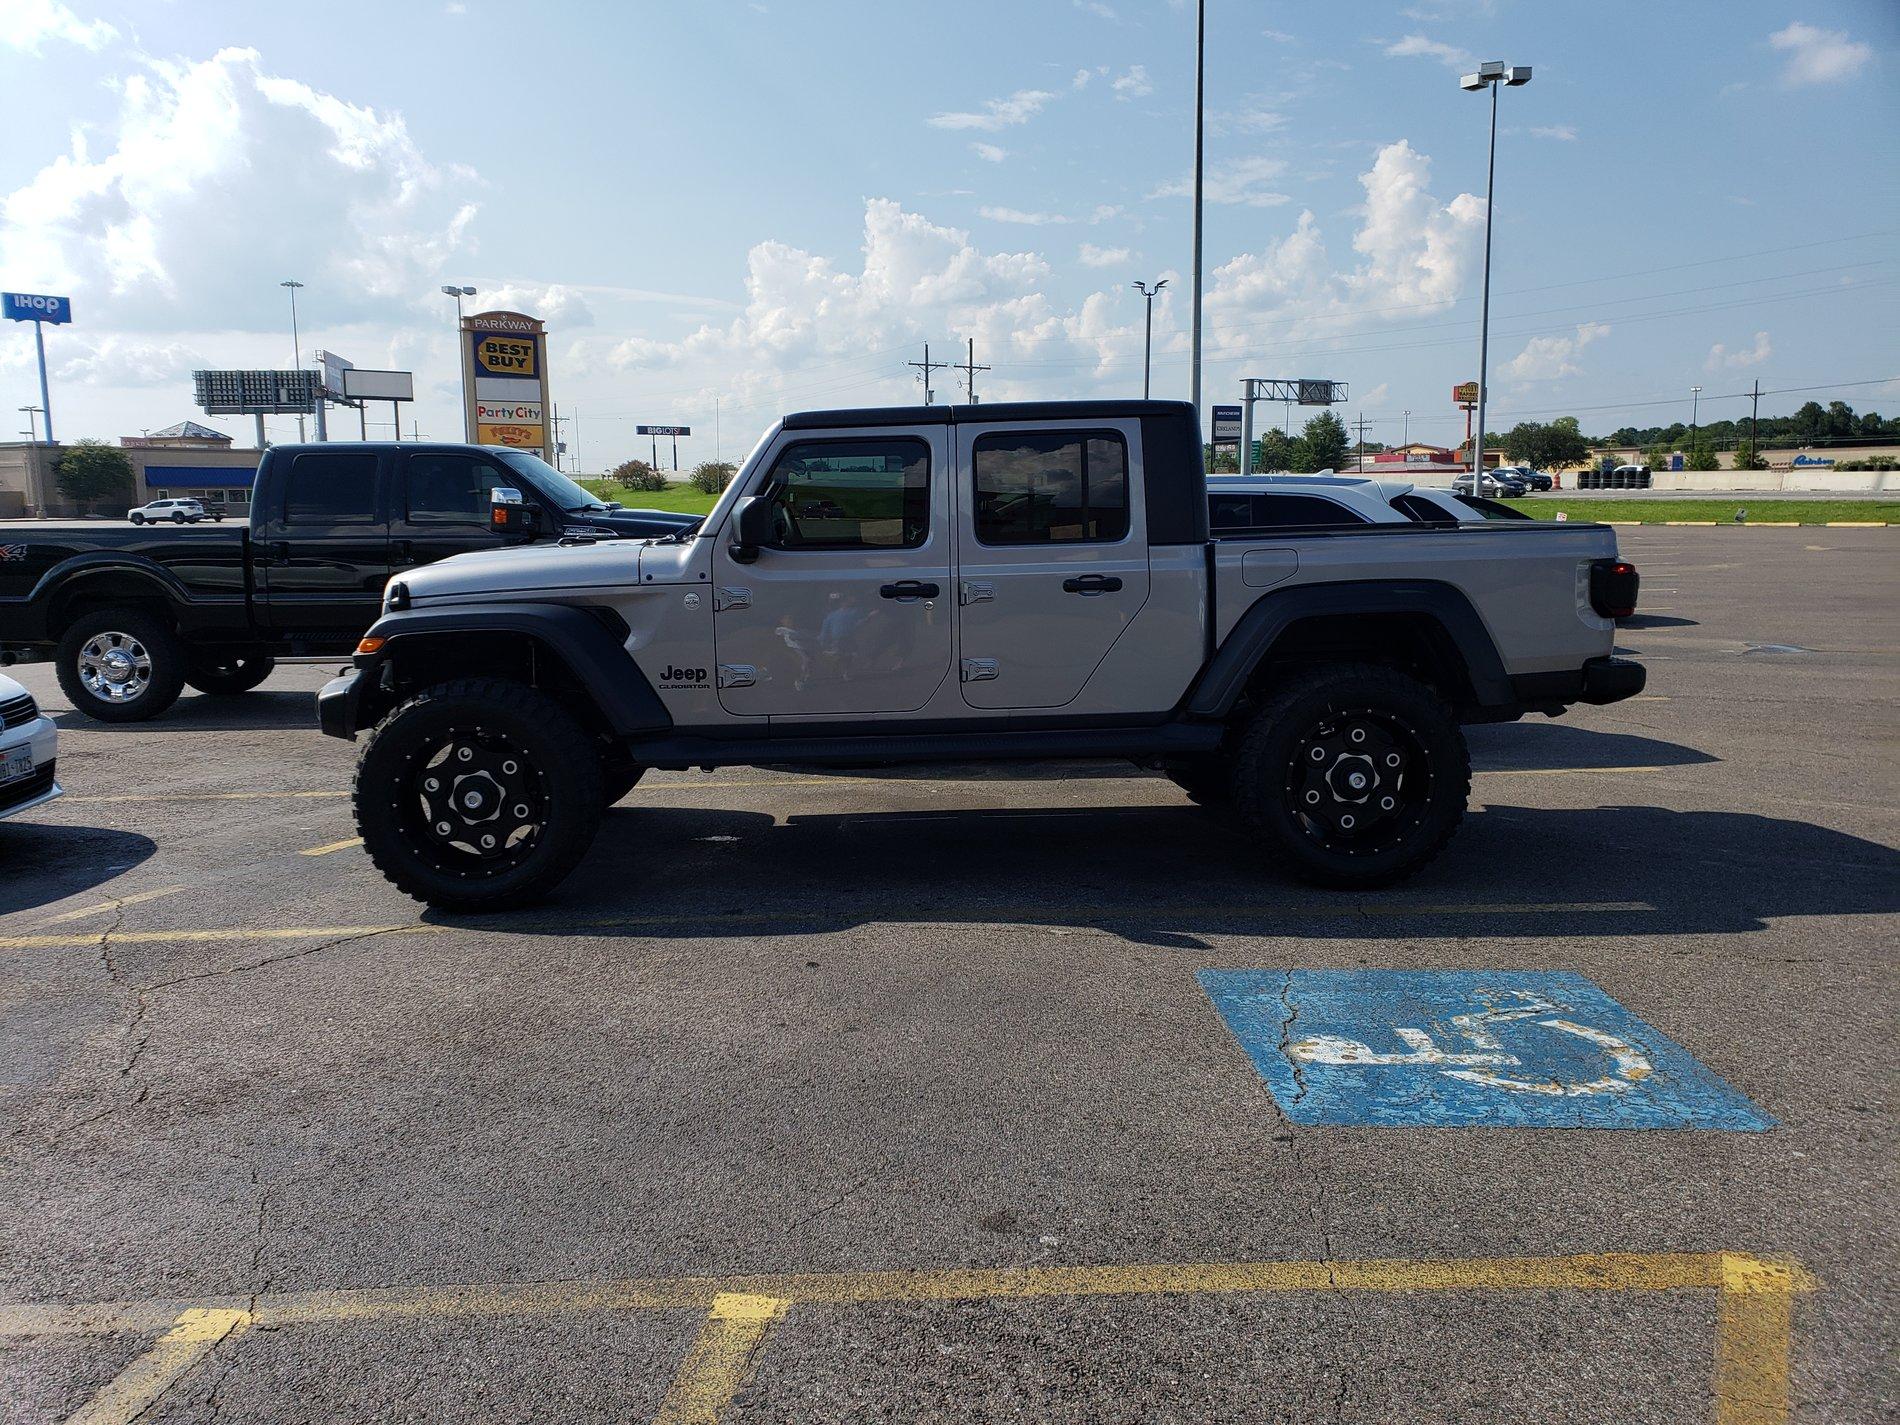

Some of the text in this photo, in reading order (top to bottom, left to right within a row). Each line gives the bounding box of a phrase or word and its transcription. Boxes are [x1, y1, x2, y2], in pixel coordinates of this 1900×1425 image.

[474, 319, 534, 330] PARKWAY
[485, 342, 532, 357] BEST
[488, 355, 527, 369] BUY
[478, 405, 541, 420] Party City
[660, 664, 708, 683] Jeep
